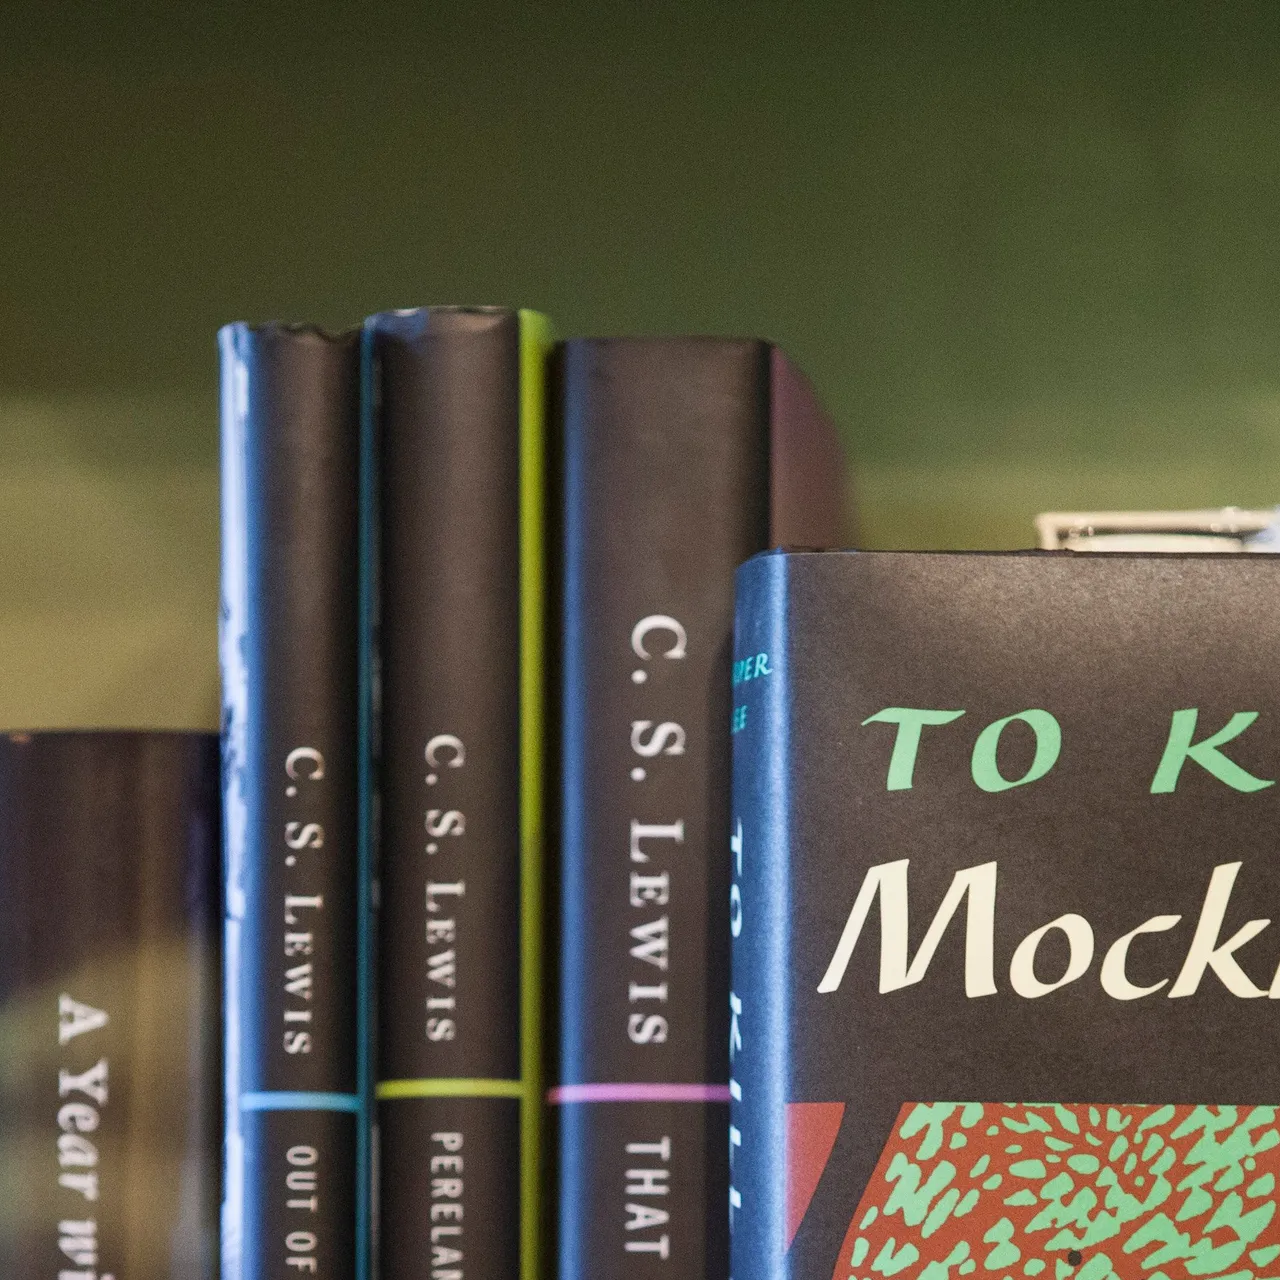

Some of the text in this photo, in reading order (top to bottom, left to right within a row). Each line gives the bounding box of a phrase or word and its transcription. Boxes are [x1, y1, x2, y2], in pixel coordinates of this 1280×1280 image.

[862, 706, 1062, 793] TO
[424, 734, 466, 1043] C. S. LEWIS
[627, 614, 688, 1044] C. S. LEWIS
[282, 746, 326, 1055] C. S. LEWIS
[58, 994, 109, 1045] A
[57, 1058, 109, 1201] Year
[285, 1145, 319, 1213] OUT
[284, 1231, 319, 1275] OF
[624, 1136, 671, 1260] THAT
